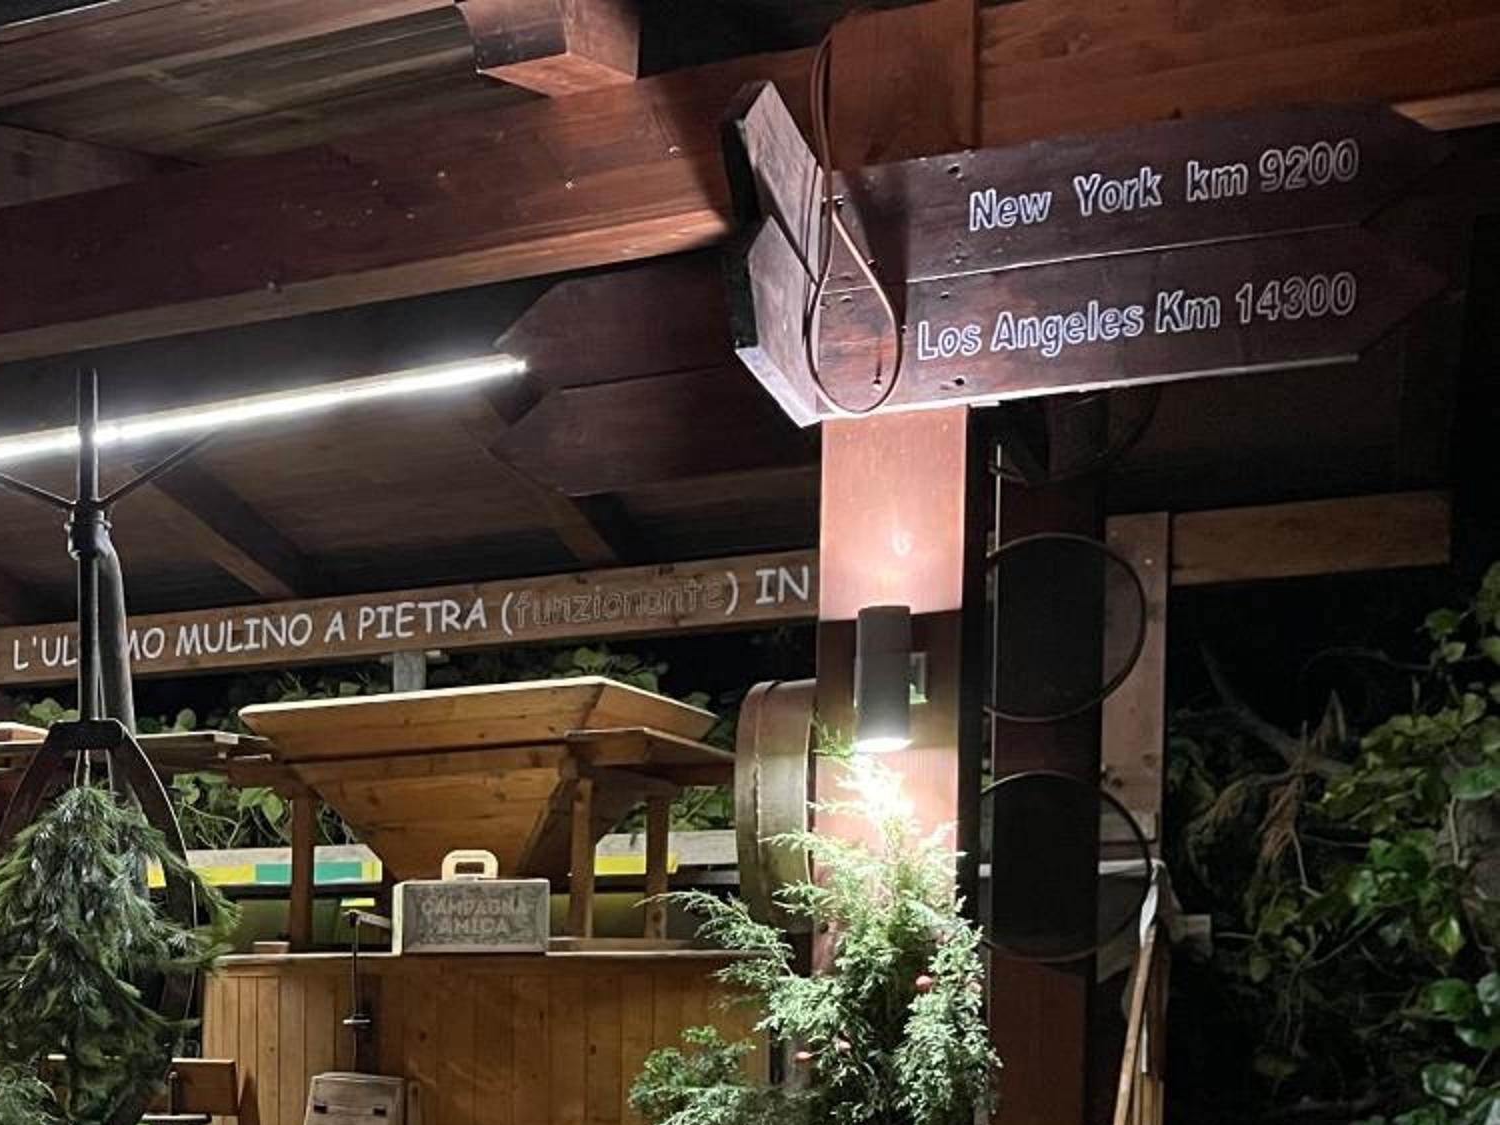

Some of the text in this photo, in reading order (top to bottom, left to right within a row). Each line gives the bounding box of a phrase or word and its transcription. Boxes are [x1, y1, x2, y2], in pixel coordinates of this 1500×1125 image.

[969, 137, 1360, 232] New York km 9200
[917, 271, 1357, 361] Los Angeles Km 14300
[13, 565, 810, 672] L'ULMO MULINO A PIETRA (funzionante) IN
